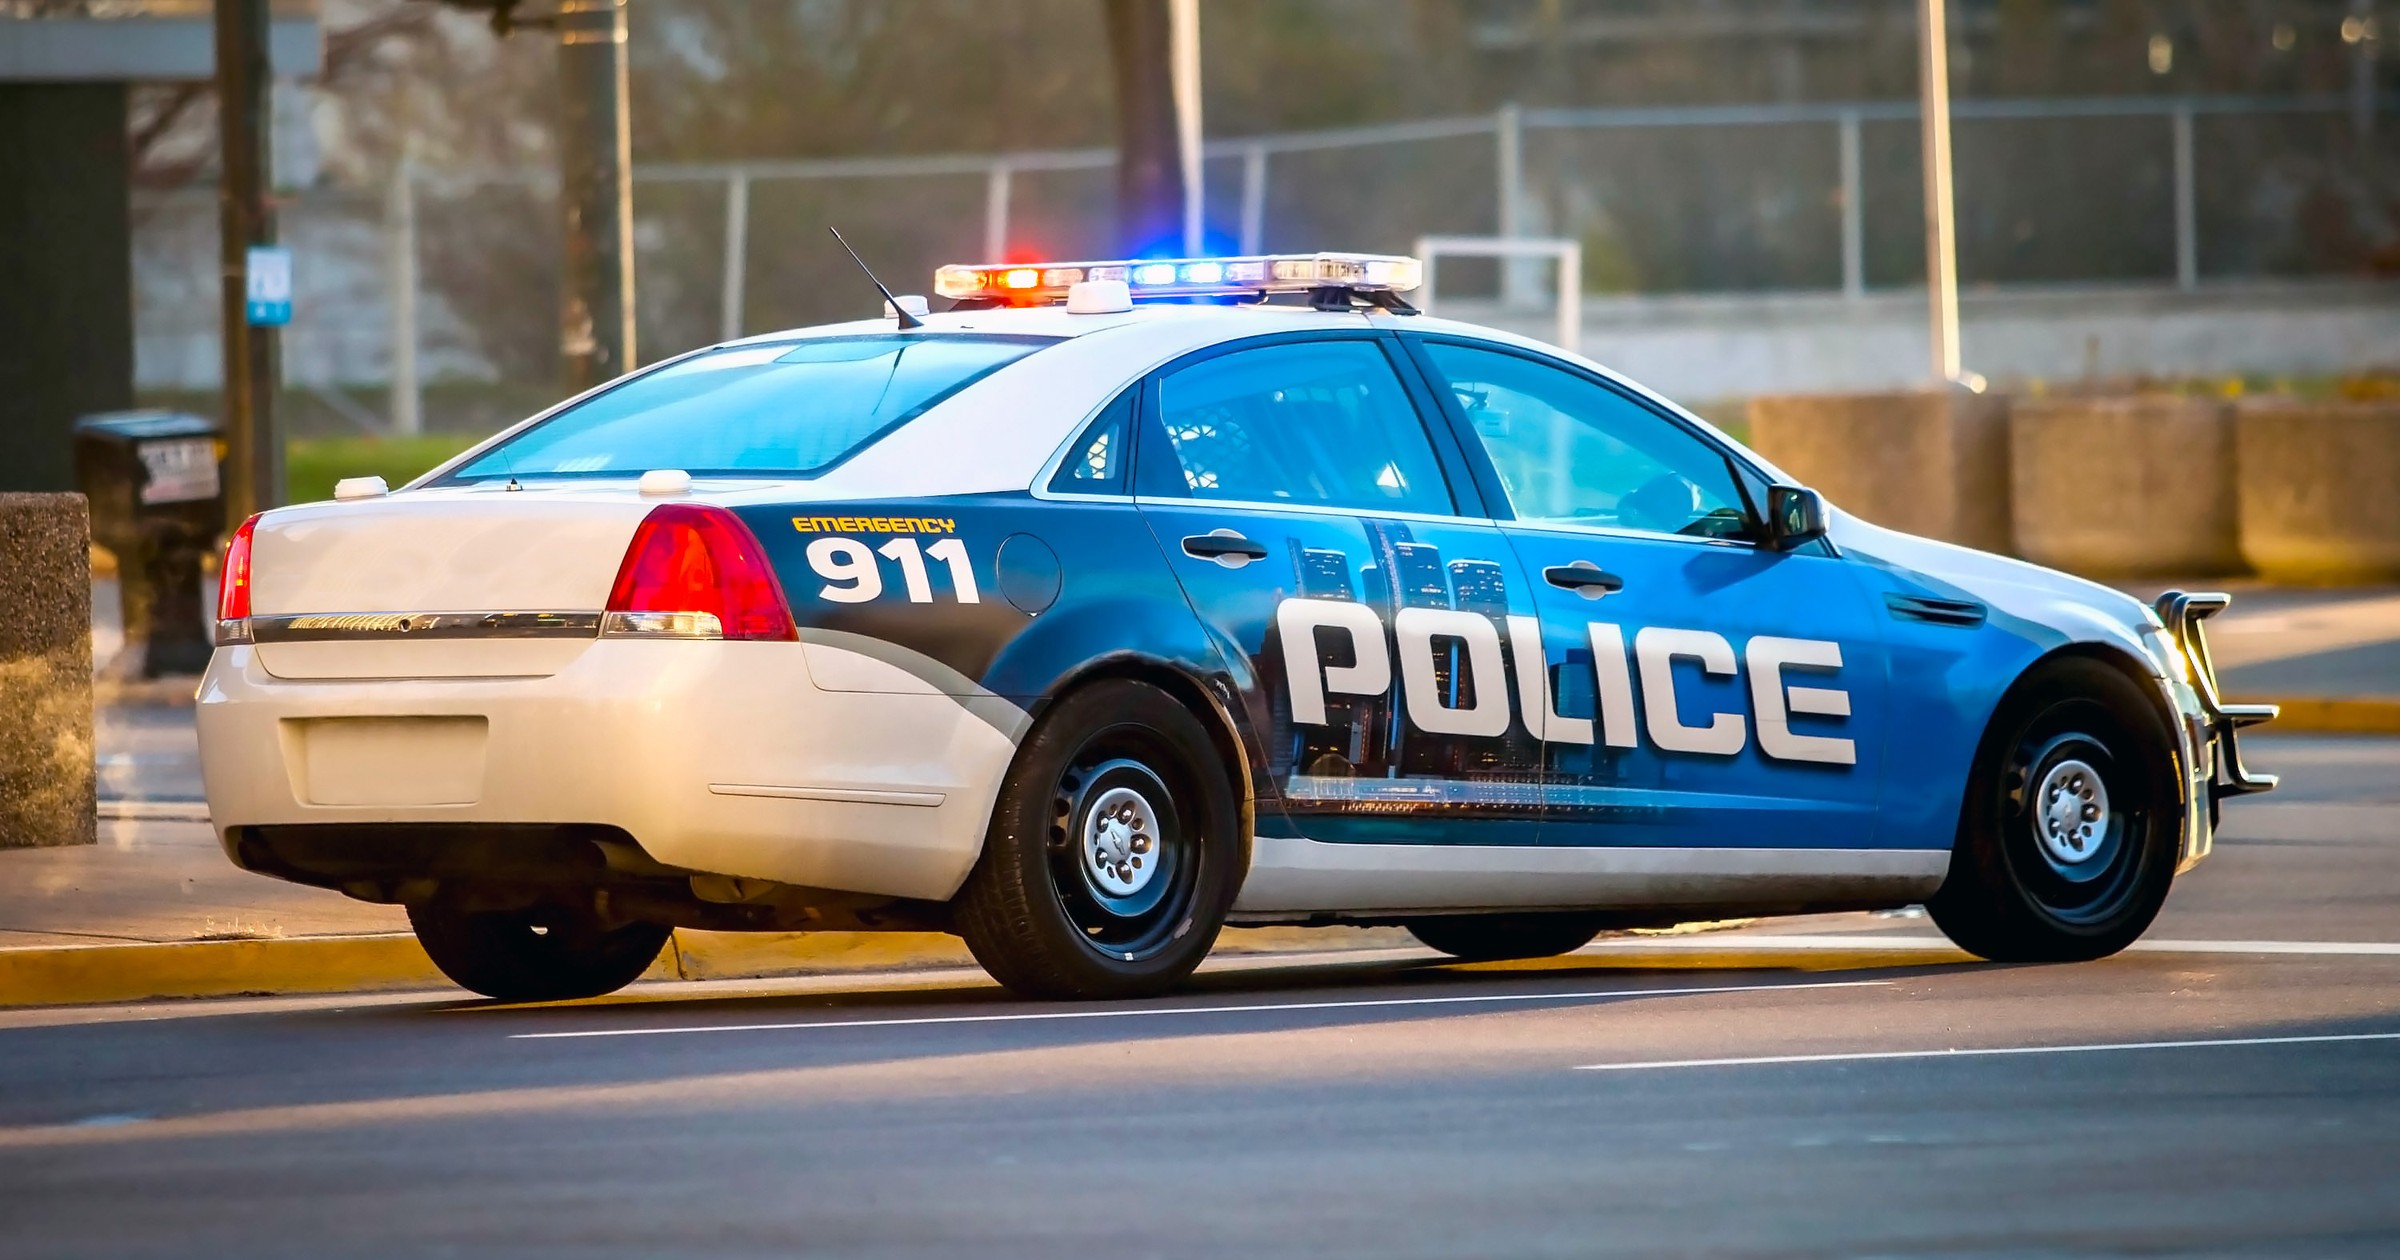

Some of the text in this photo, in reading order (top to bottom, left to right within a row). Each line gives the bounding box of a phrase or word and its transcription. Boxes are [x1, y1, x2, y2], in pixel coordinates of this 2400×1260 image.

[792, 516, 956, 533] EMERGENCY
[806, 537, 981, 604] 911
[1276, 598, 1857, 764] POLICE
